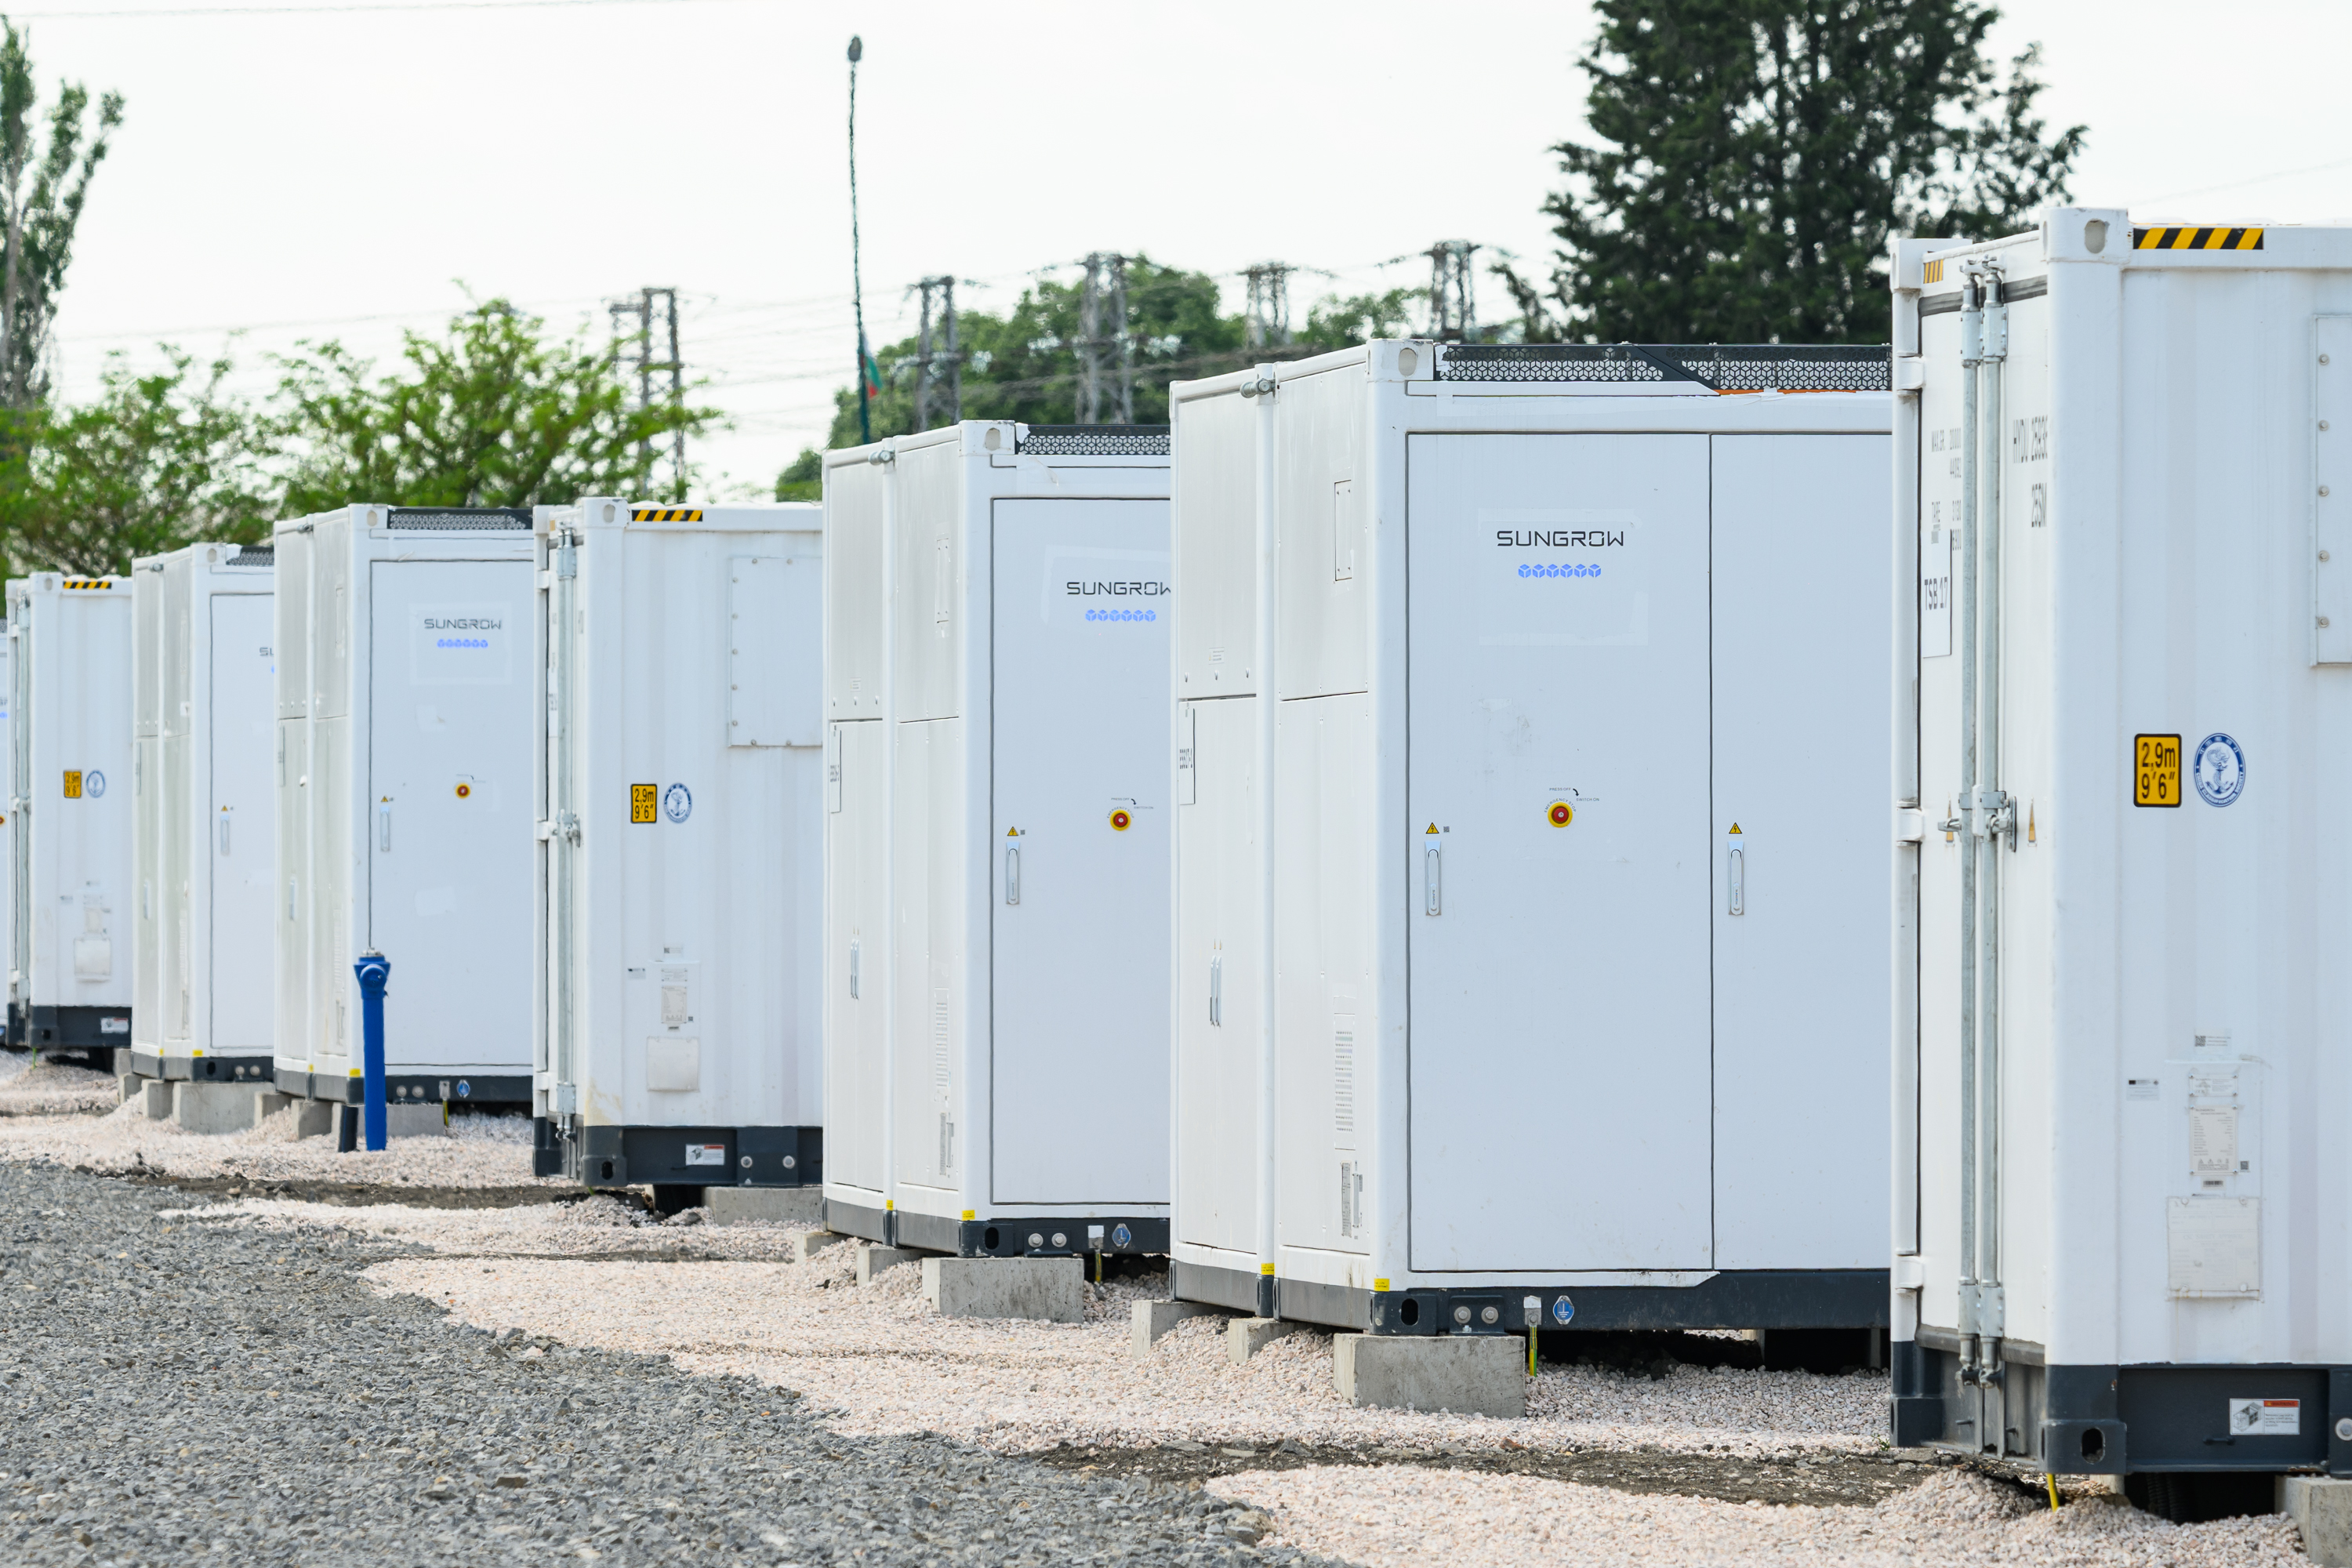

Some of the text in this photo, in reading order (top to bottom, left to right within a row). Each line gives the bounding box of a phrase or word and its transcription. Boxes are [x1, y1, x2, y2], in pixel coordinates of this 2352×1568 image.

[1497, 531, 1624, 546] SUNGROW
[1067, 582, 1171, 595] SUNGROW
[1925, 576, 1948, 611] TSB 17
[424, 619, 501, 630] SUNGROW
[1107, 806, 1127, 818] EMERGENCY
[1544, 798, 1577, 813] EMERGENCY STOP
